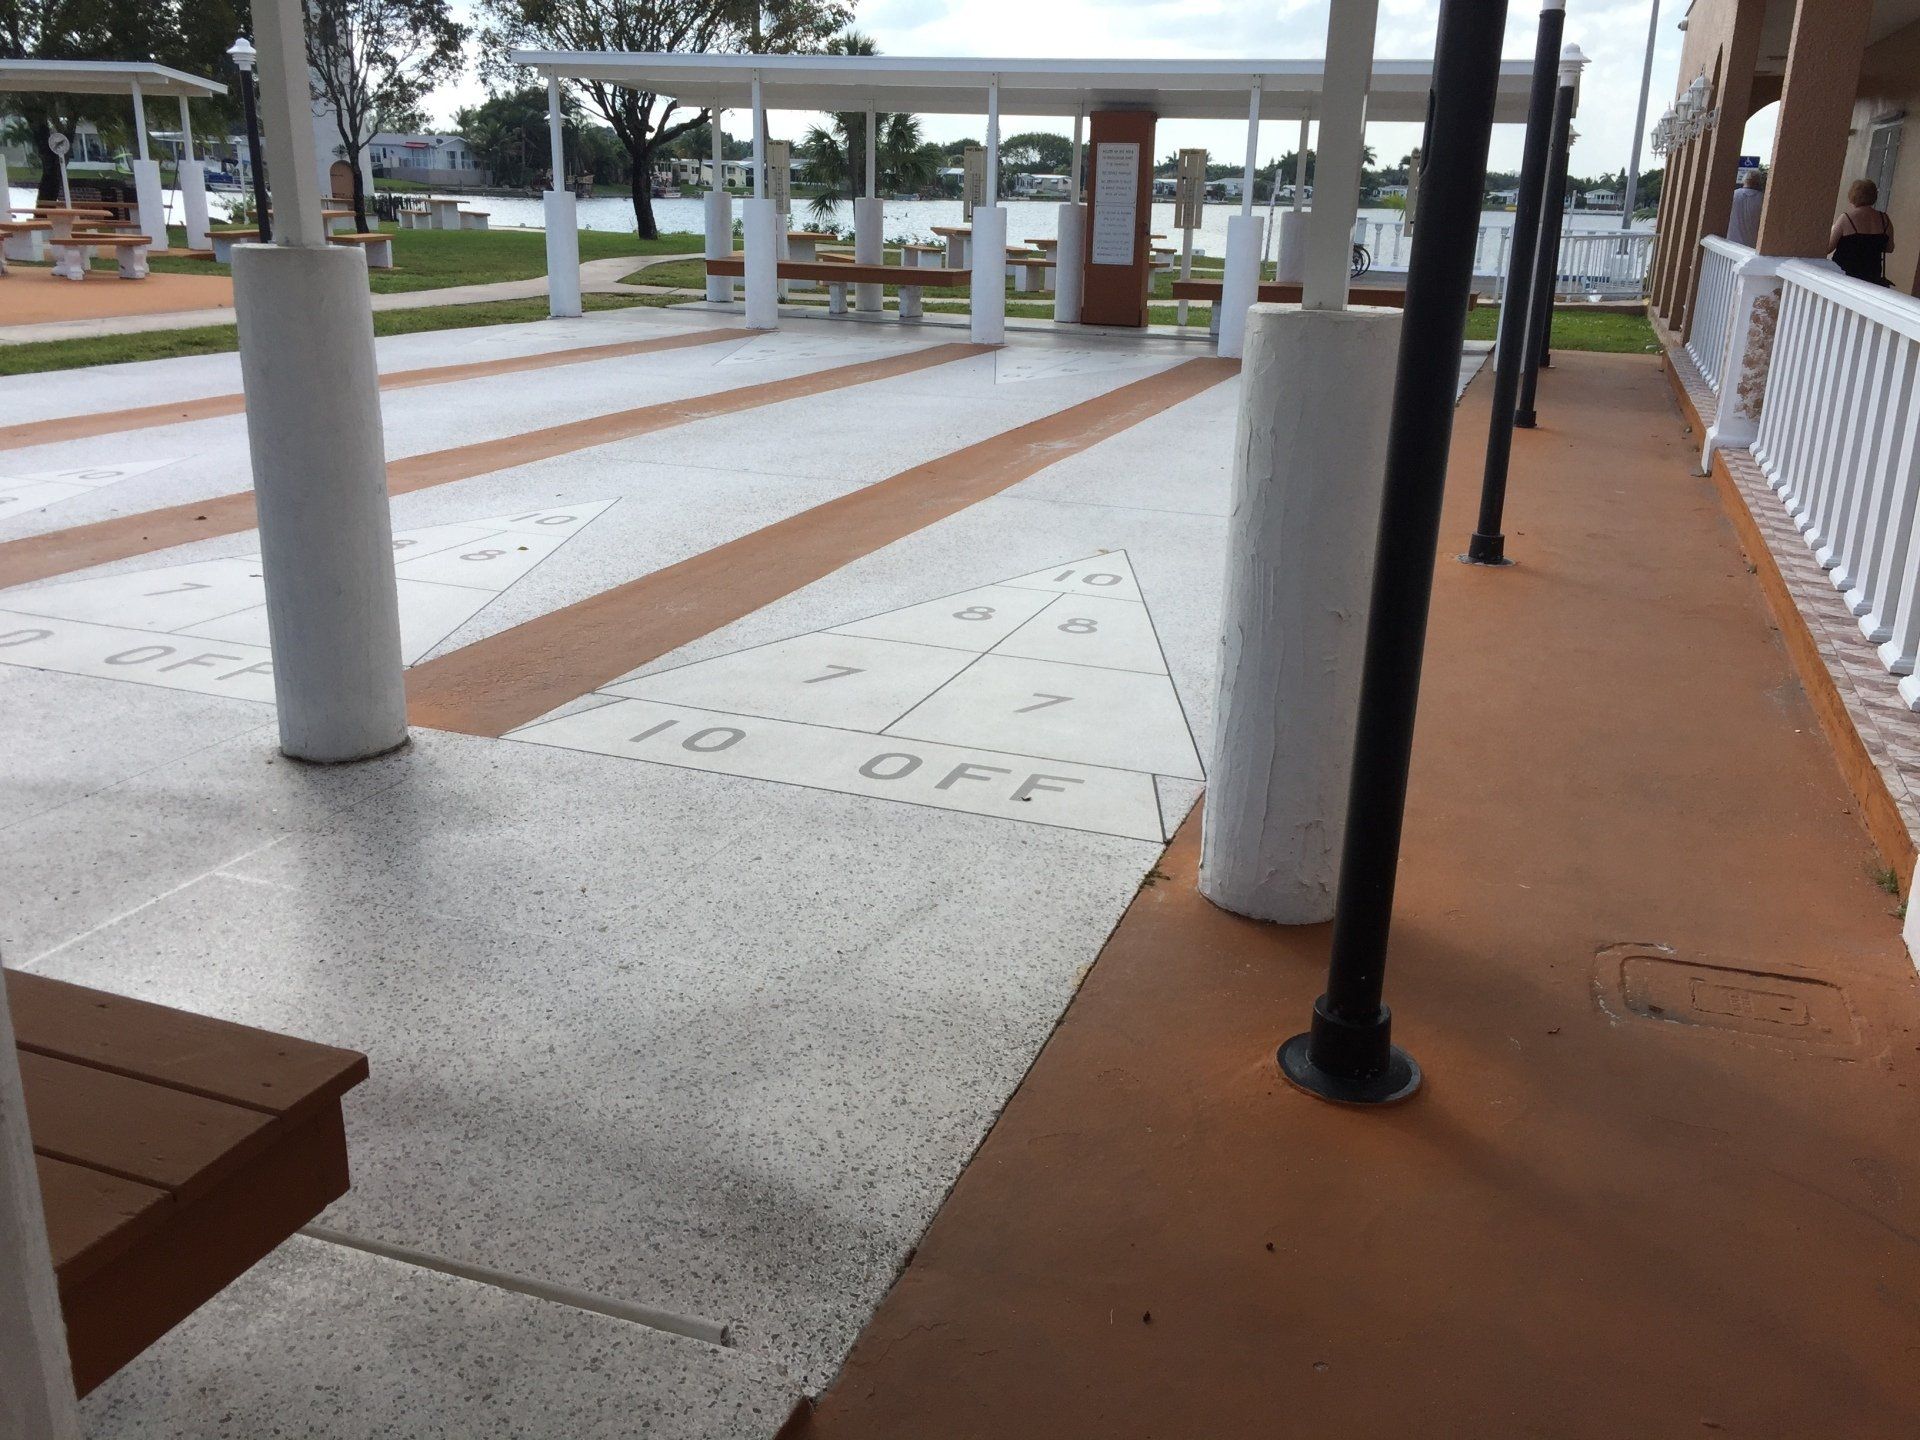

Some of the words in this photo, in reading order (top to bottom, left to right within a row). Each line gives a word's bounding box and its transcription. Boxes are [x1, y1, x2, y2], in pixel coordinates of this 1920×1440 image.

[509, 513, 578, 525] 10
[459, 549, 506, 561] 8
[1053, 569, 1123, 586] 10
[142, 582, 213, 596] 7
[952, 605, 996, 621] 8
[1057, 617, 1098, 634] 8
[803, 664, 867, 684] 7
[1013, 692, 1075, 714] 7
[629, 719, 747, 753] 10
[858, 752, 1086, 801] OFF
